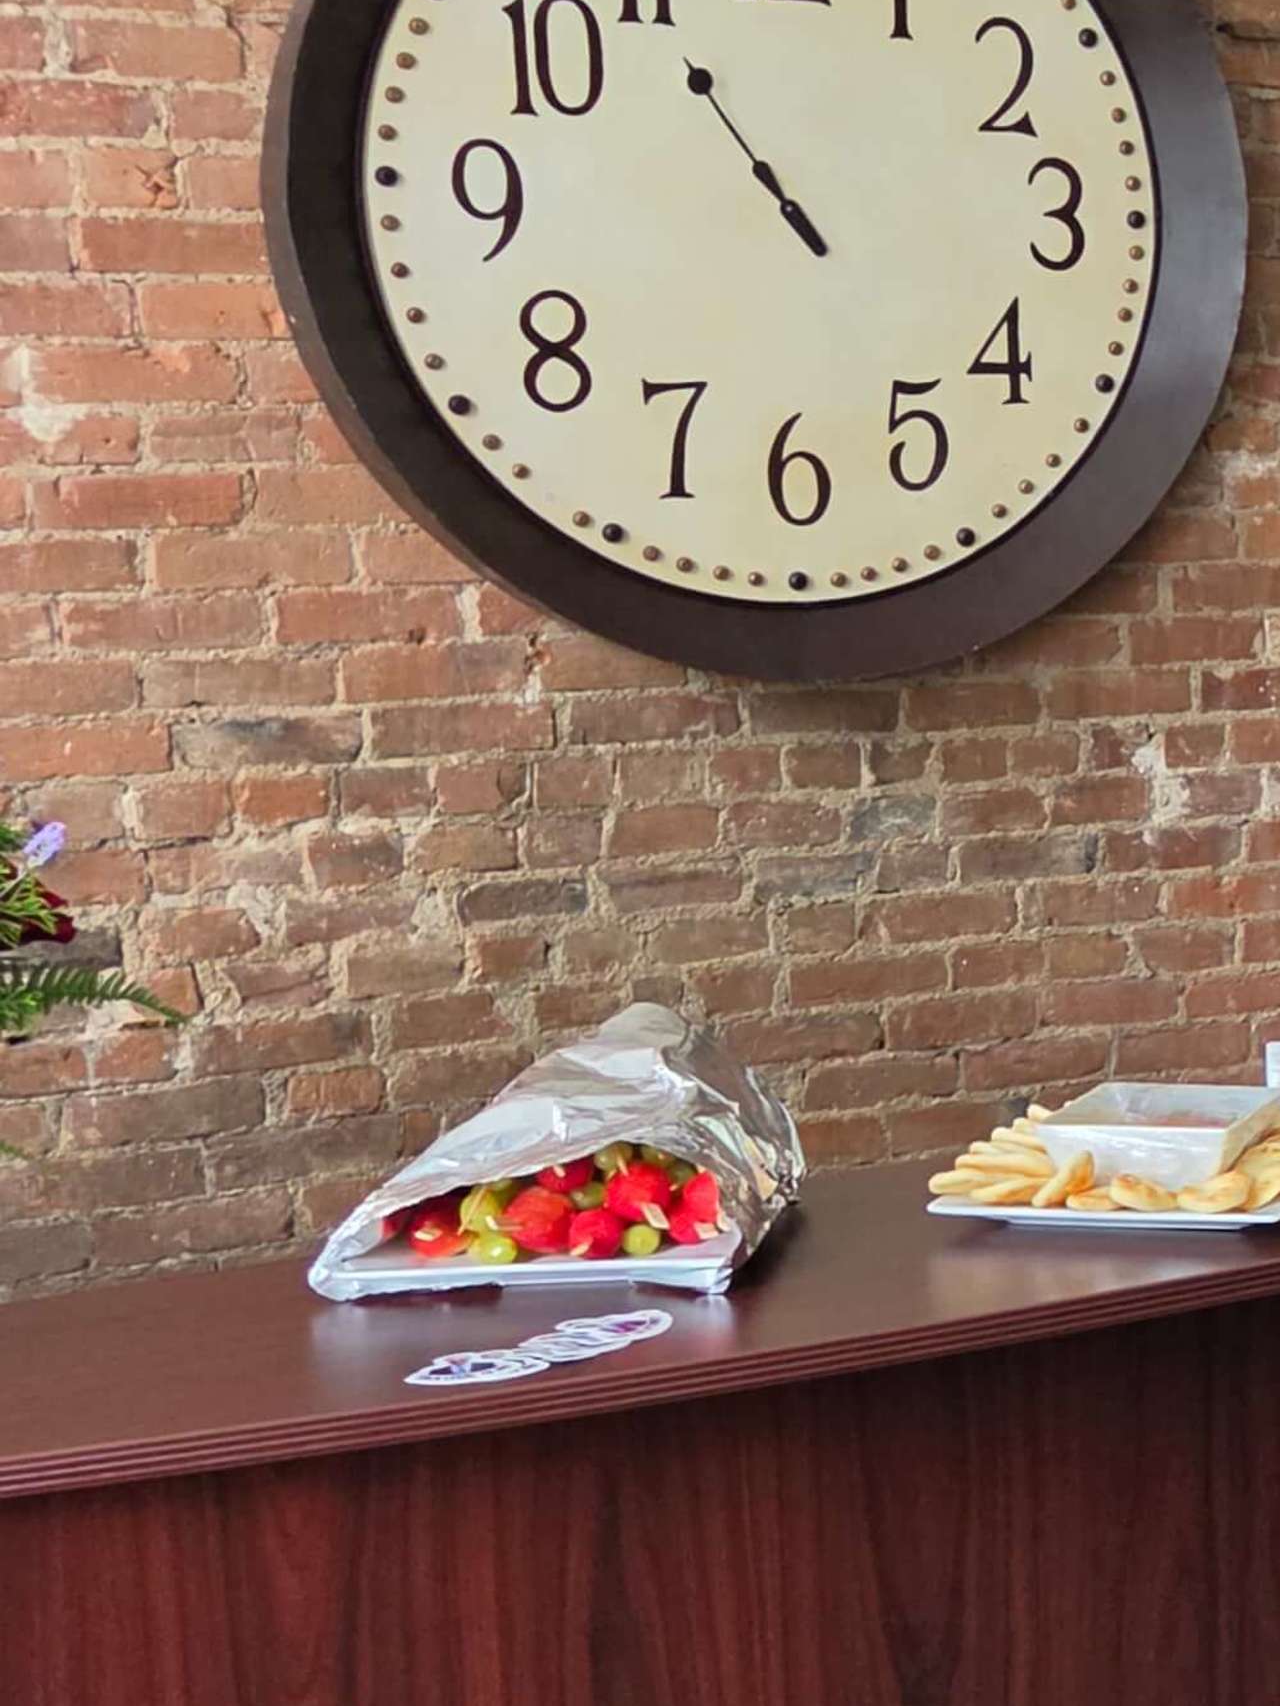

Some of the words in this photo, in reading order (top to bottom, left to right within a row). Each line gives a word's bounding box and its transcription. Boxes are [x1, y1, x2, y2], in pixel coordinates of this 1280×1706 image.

[974, 16, 1038, 138] 2
[451, 138, 524, 262] 9
[1027, 156, 1086, 272] 3
[519, 289, 592, 413] 8
[966, 296, 1033, 405] 4
[641, 378, 708, 500] 7
[767, 412, 832, 527] 6
[888, 378, 949, 492] 5
